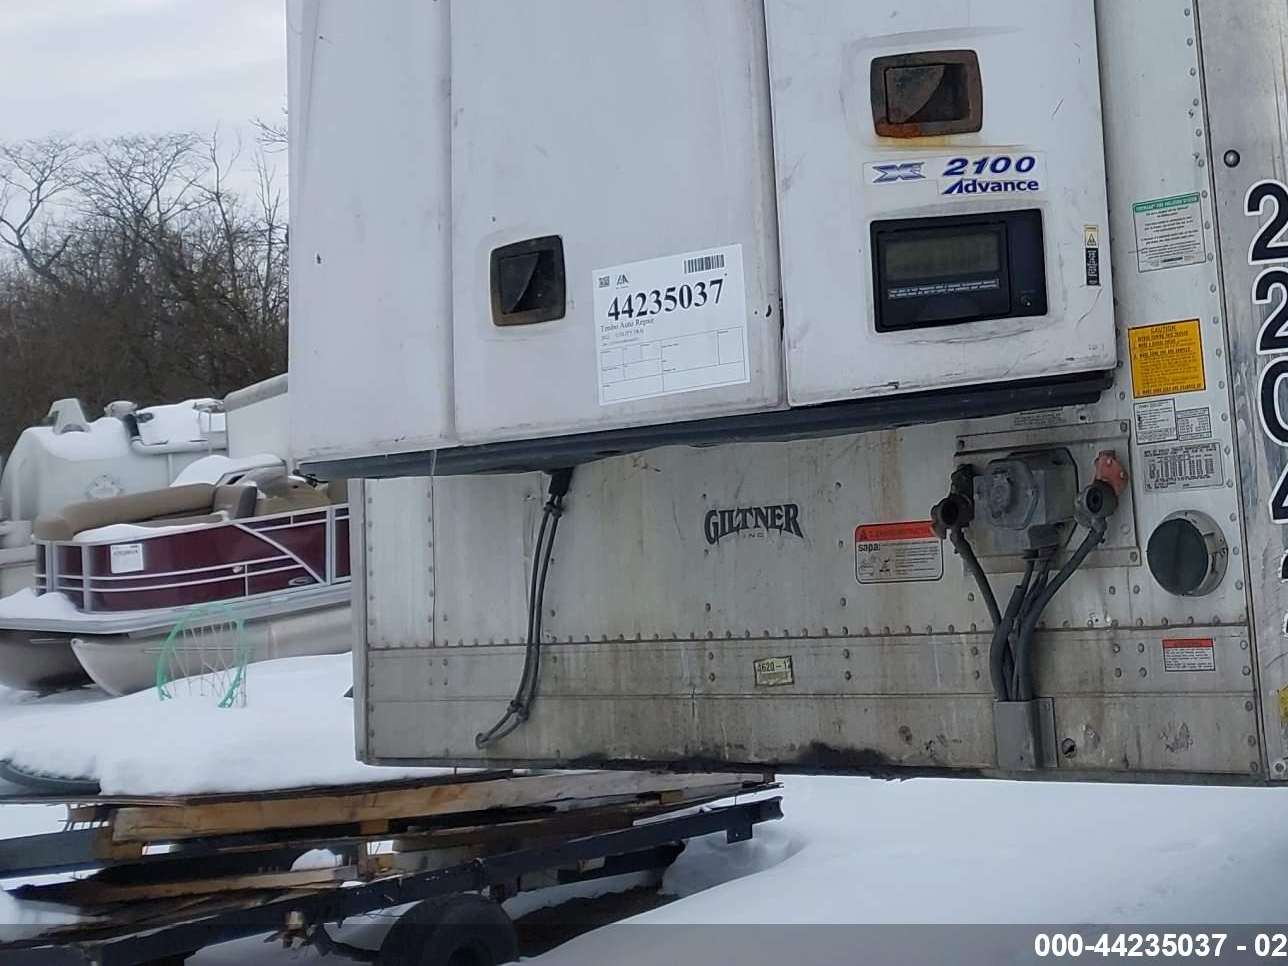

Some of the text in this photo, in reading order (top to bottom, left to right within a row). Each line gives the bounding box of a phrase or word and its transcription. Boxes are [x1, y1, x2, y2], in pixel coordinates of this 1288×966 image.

[942, 156, 1036, 177] 2100
[941, 178, 1039, 195] Advance
[607, 278, 724, 321] 44235037
[704, 503, 804, 545] GILTNER
